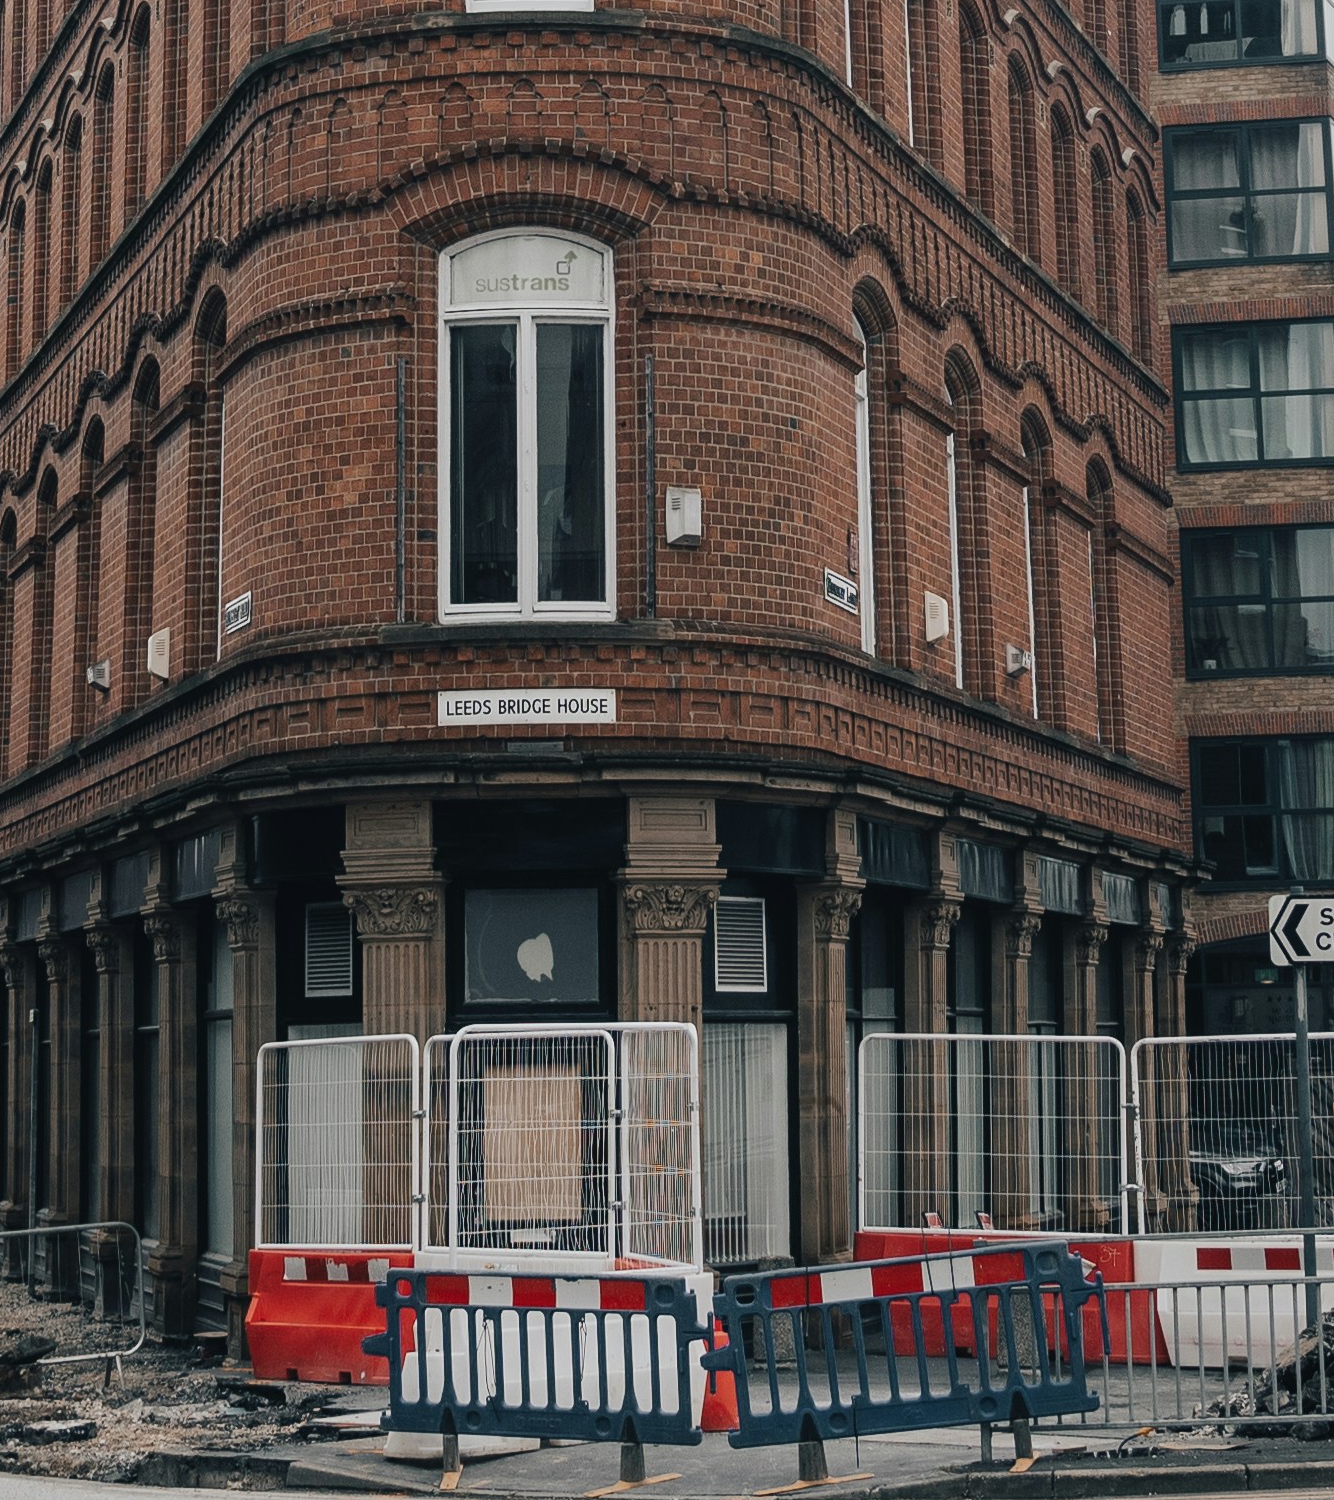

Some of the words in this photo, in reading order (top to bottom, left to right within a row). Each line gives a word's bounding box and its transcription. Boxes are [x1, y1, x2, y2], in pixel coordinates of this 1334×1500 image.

[475, 273, 570, 292] sustrans
[446, 700, 492, 716] LEEDS
[498, 698, 551, 715] BRIDGE
[557, 698, 609, 714] HOUSE
